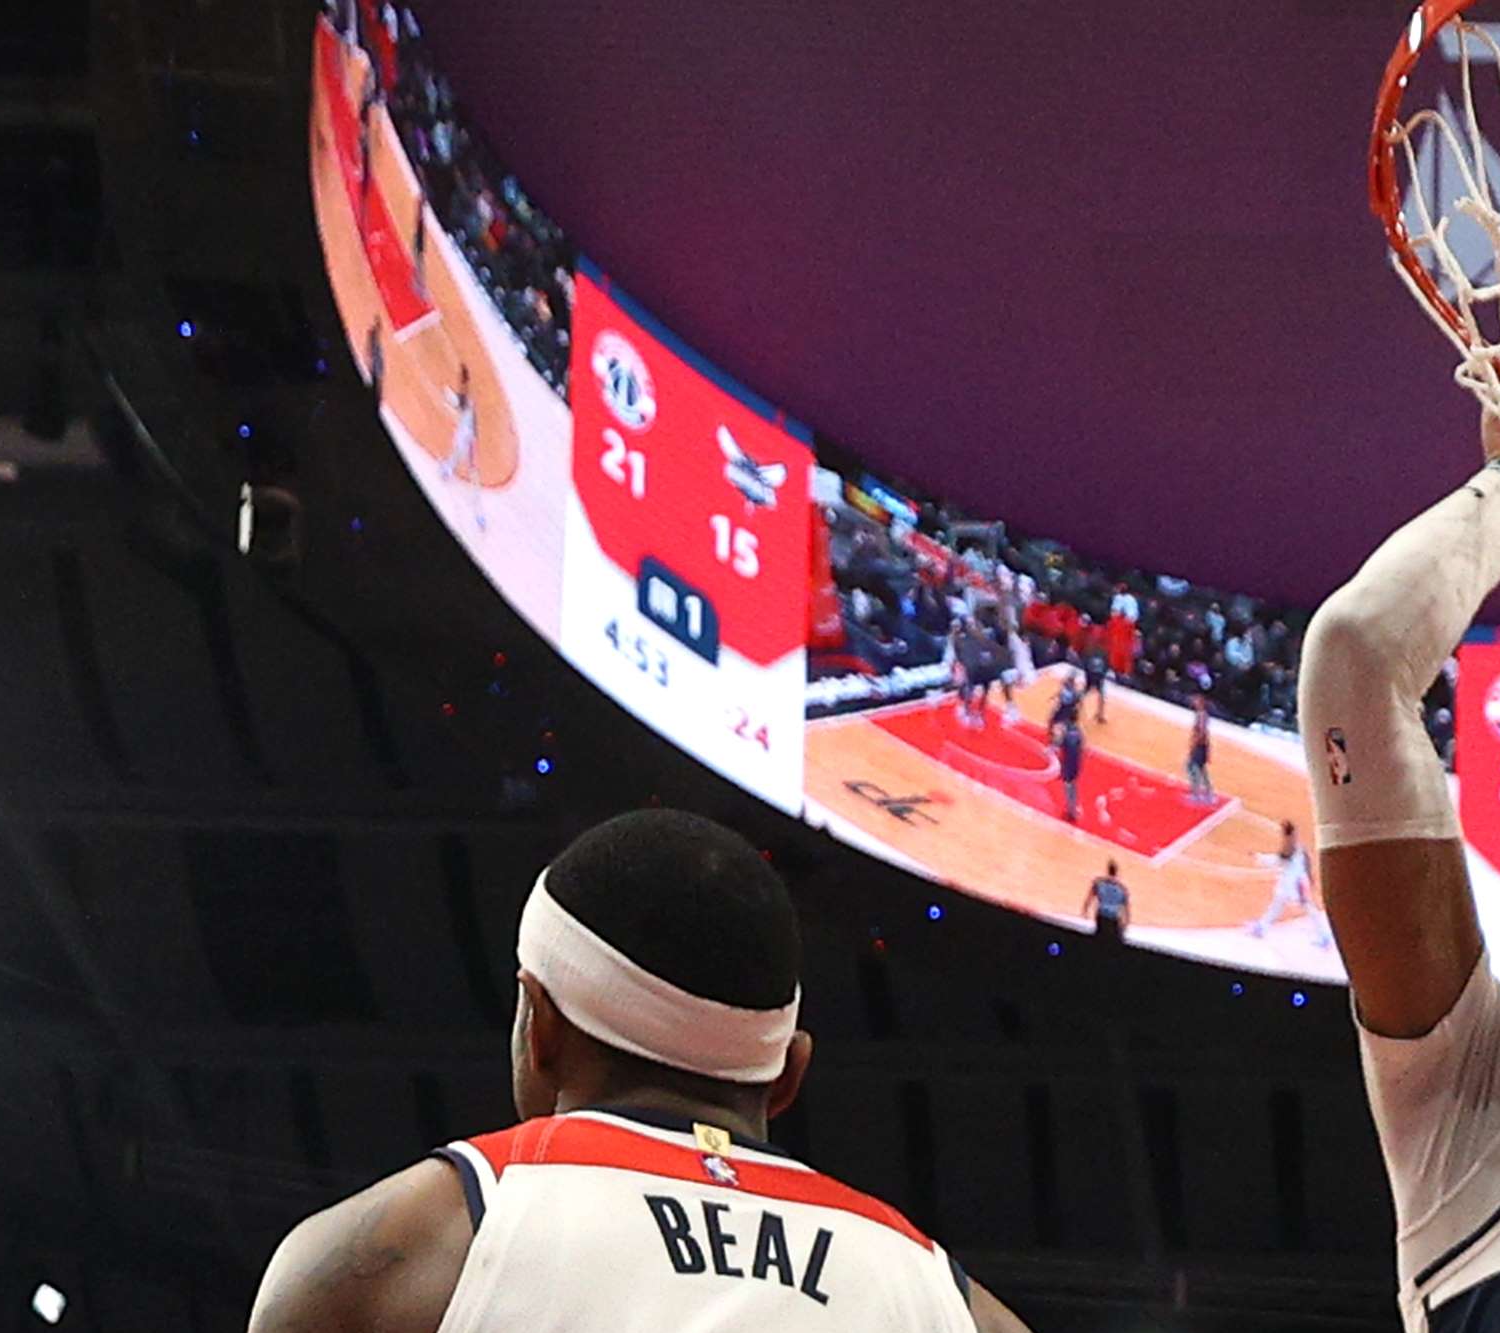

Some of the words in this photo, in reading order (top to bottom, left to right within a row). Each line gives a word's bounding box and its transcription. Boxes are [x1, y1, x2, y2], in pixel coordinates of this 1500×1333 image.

[600, 427, 646, 500] 21
[710, 513, 760, 579] 15
[683, 594, 702, 640] 1
[603, 618, 669, 688] 4:53
[643, 1193, 834, 1306] BEAL
